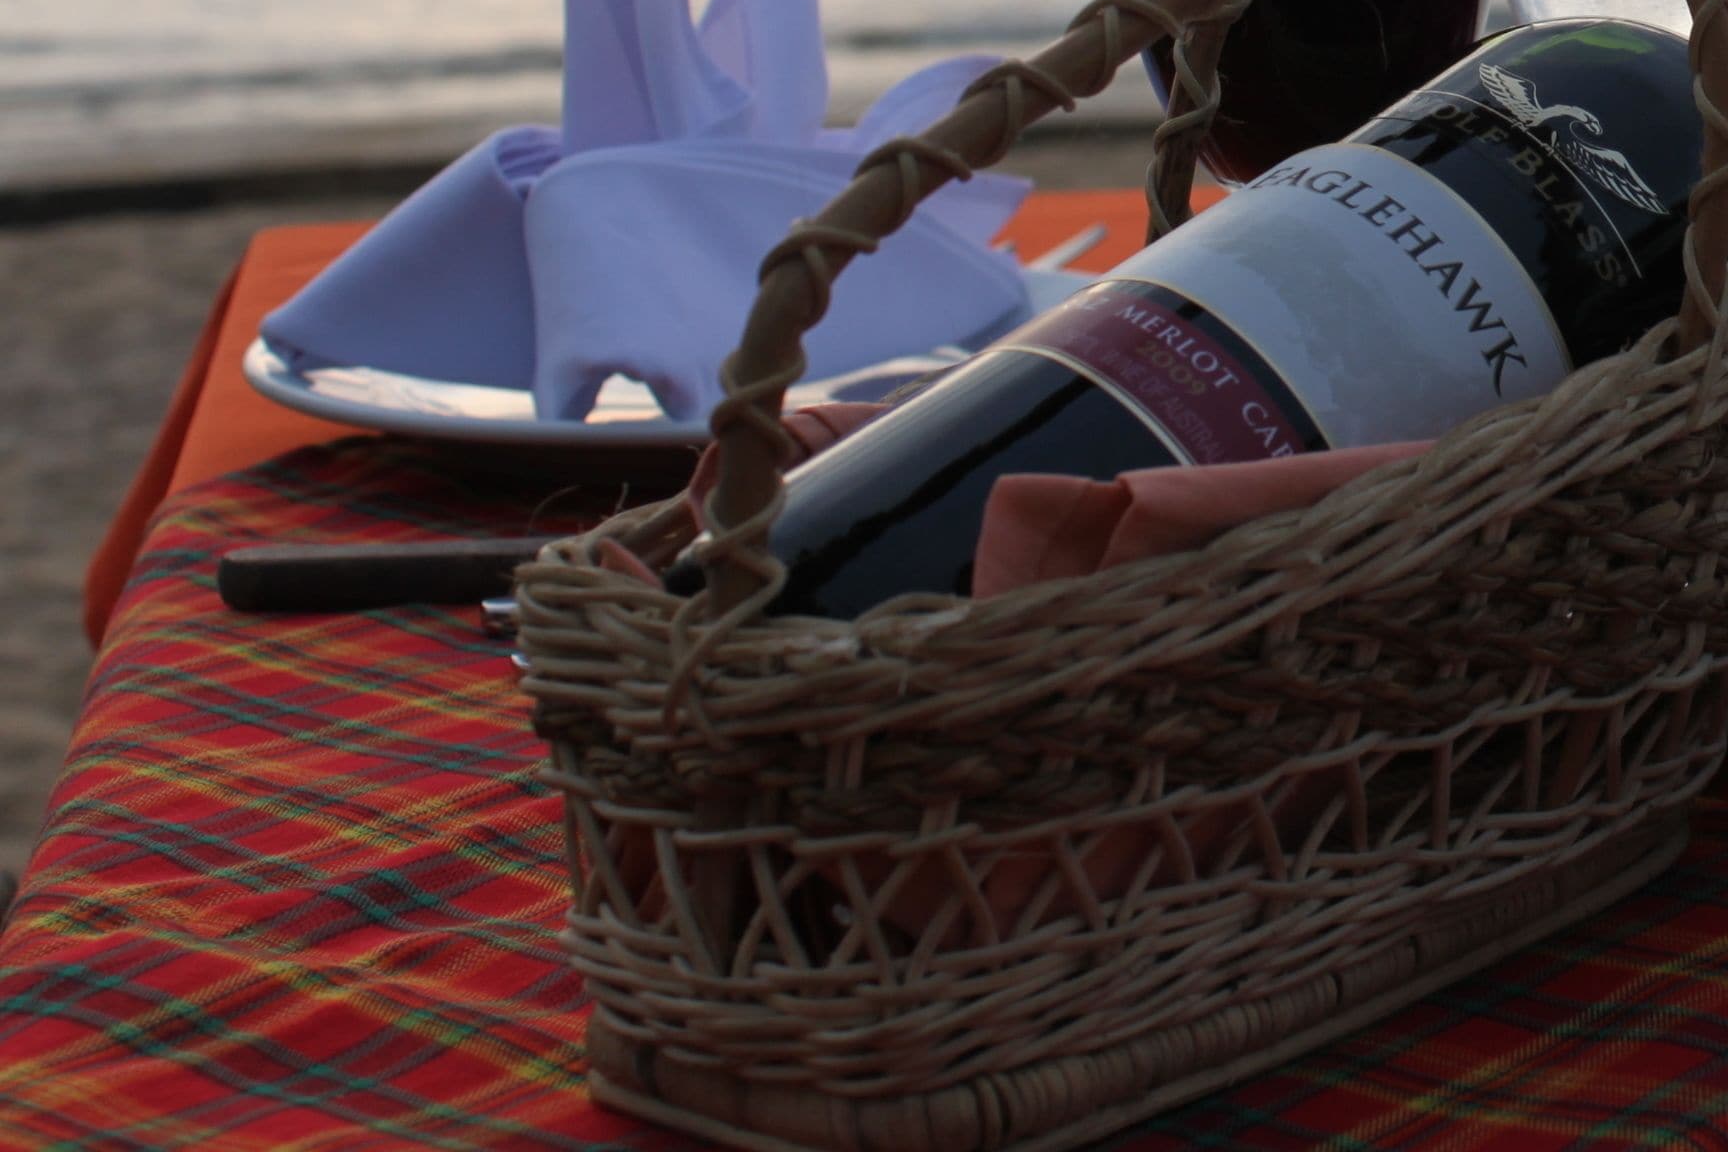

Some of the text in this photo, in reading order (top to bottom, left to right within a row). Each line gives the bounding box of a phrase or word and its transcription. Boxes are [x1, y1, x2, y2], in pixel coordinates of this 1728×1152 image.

[1506, 147, 1623, 281] BLASS
[1114, 304, 1240, 390] MERLOT
[1251, 166, 1528, 398] EAGLEHAWK
